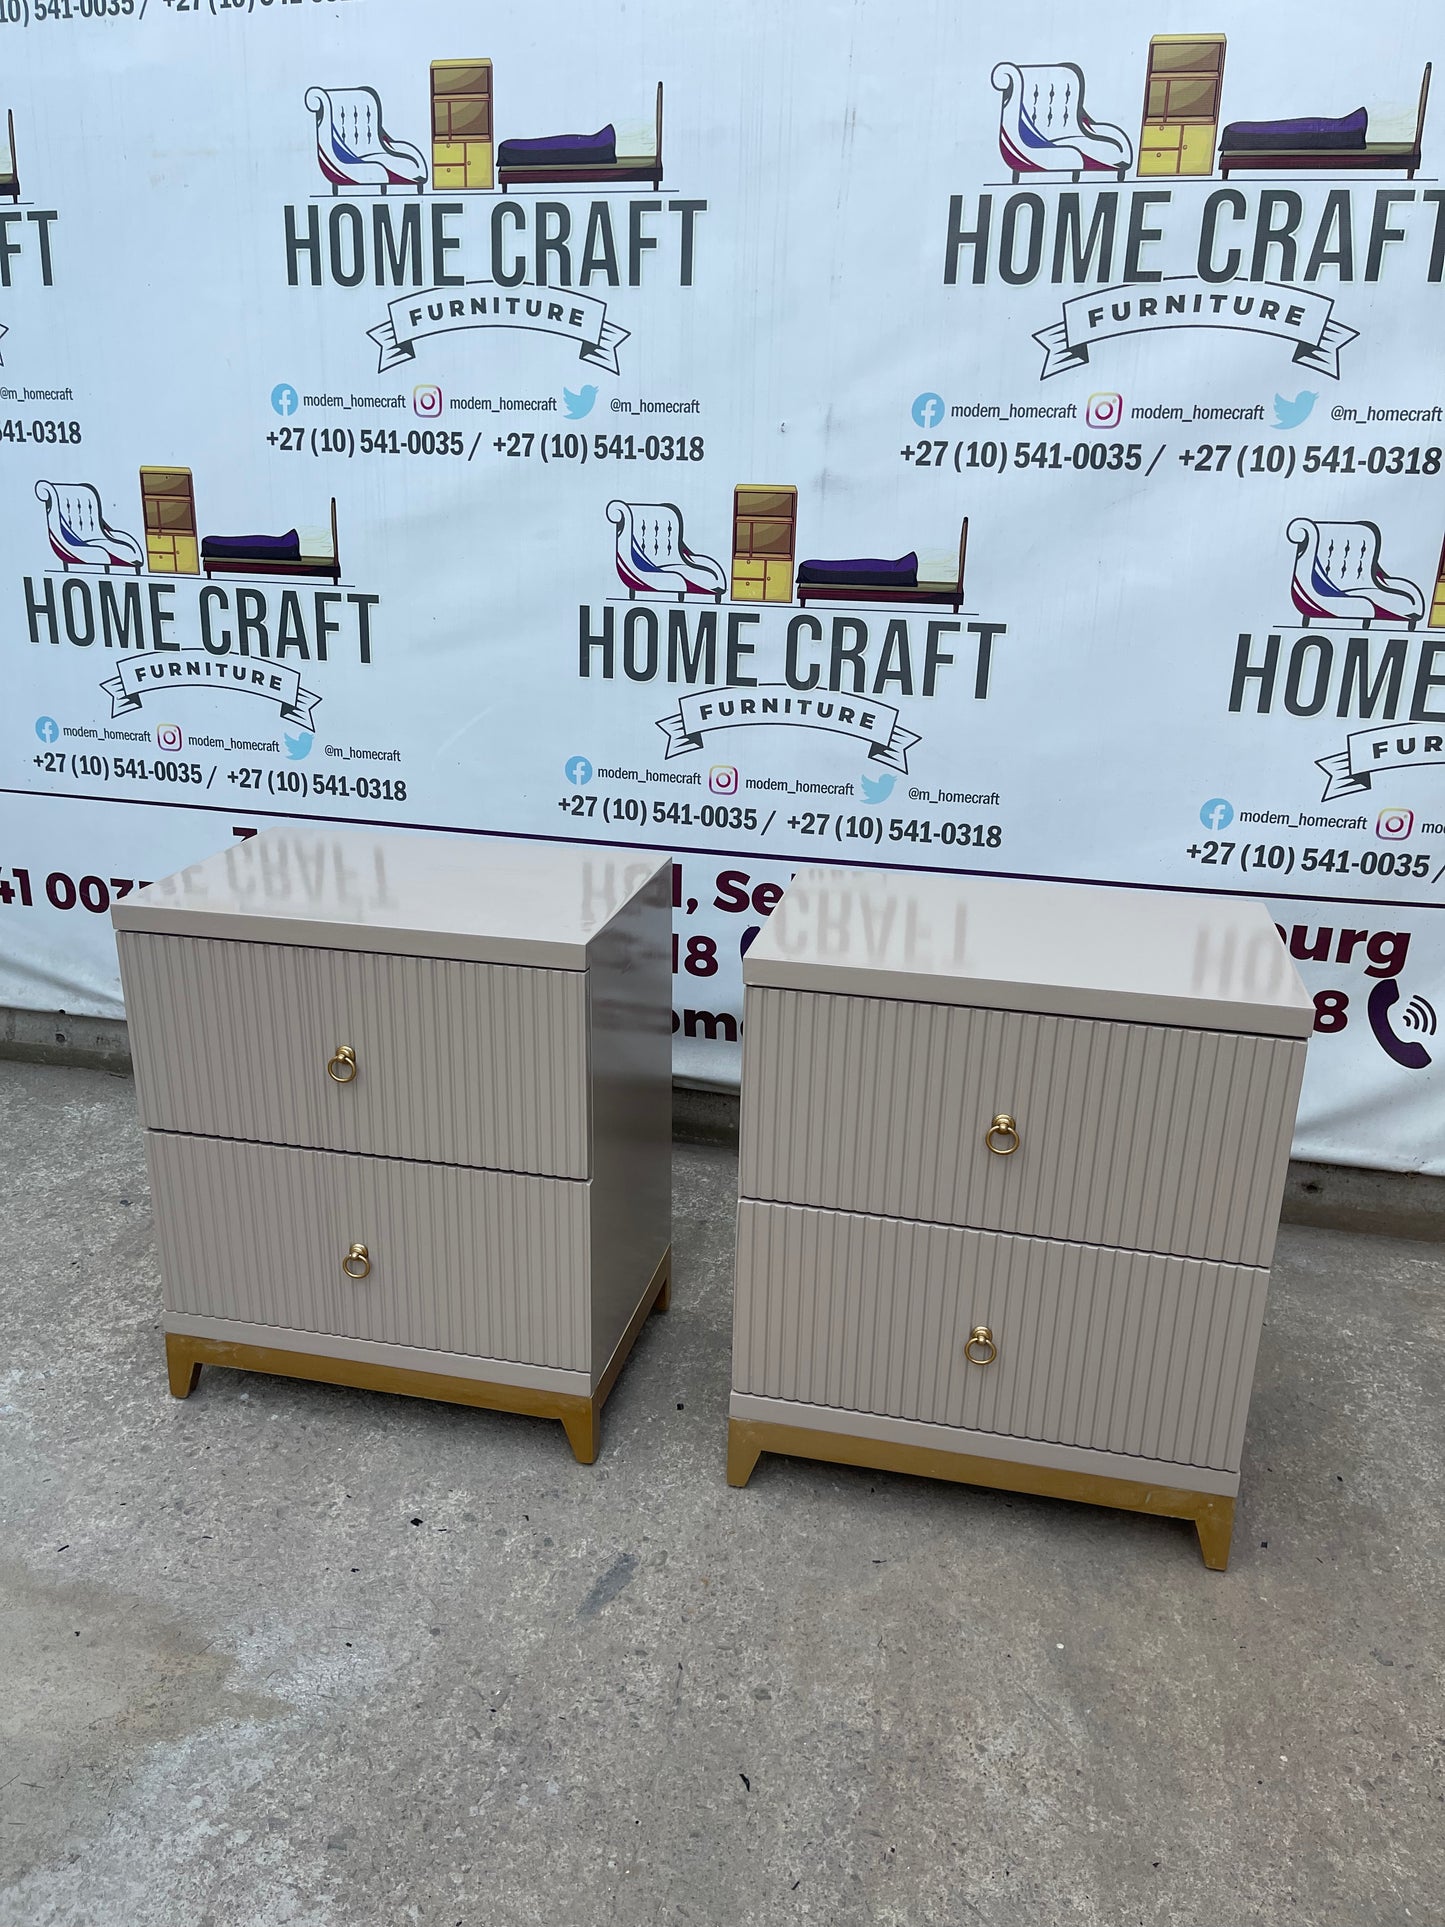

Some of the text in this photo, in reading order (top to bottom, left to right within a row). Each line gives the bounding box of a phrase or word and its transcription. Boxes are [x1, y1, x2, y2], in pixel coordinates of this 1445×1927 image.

[283, 200, 708, 287] HOME CRAFT
[943, 188, 1445, 285] HOME CRAFT
[409, 296, 587, 328] FURNITURE
[1087, 293, 1307, 328] FURNITURE
[0, 387, 74, 402] @m_homecraft
[610, 398, 701, 415] @m_homecraft
[0, 419, 82, 444] 41-0318
[1330, 405, 1443, 424] @m_homecraft
[266, 427, 704, 464] +27 (10) 541-0035 / +27 (10) 541-0318
[900, 440, 1443, 479] +27 (10) 541-0035 / +27 (10) 541-0318
[23, 576, 380, 664] HOME CRAFT
[579, 604, 1007, 700] HOME CRAFT
[134, 661, 284, 692] FURNITURE
[1228, 633, 1445, 722] HOME
[700, 697, 877, 730] FURNITURE
[325, 744, 401, 762] @m_homecraft
[33, 752, 407, 801] +27 (10) 541-0035 / +27 (10) 541-0318
[908, 787, 1000, 805] @m_homecraft
[558, 795, 1002, 848] +27 (10) 541-0035 / +27 (10) 541-0318
[1186, 840, 1236, 866] +27
[1241, 843, 1295, 875] (10)
[1301, 848, 1431, 878] 541-0035
[45, 871, 155, 913] 00
[713, 866, 796, 917] Se
[1274, 922, 1412, 978] urg
